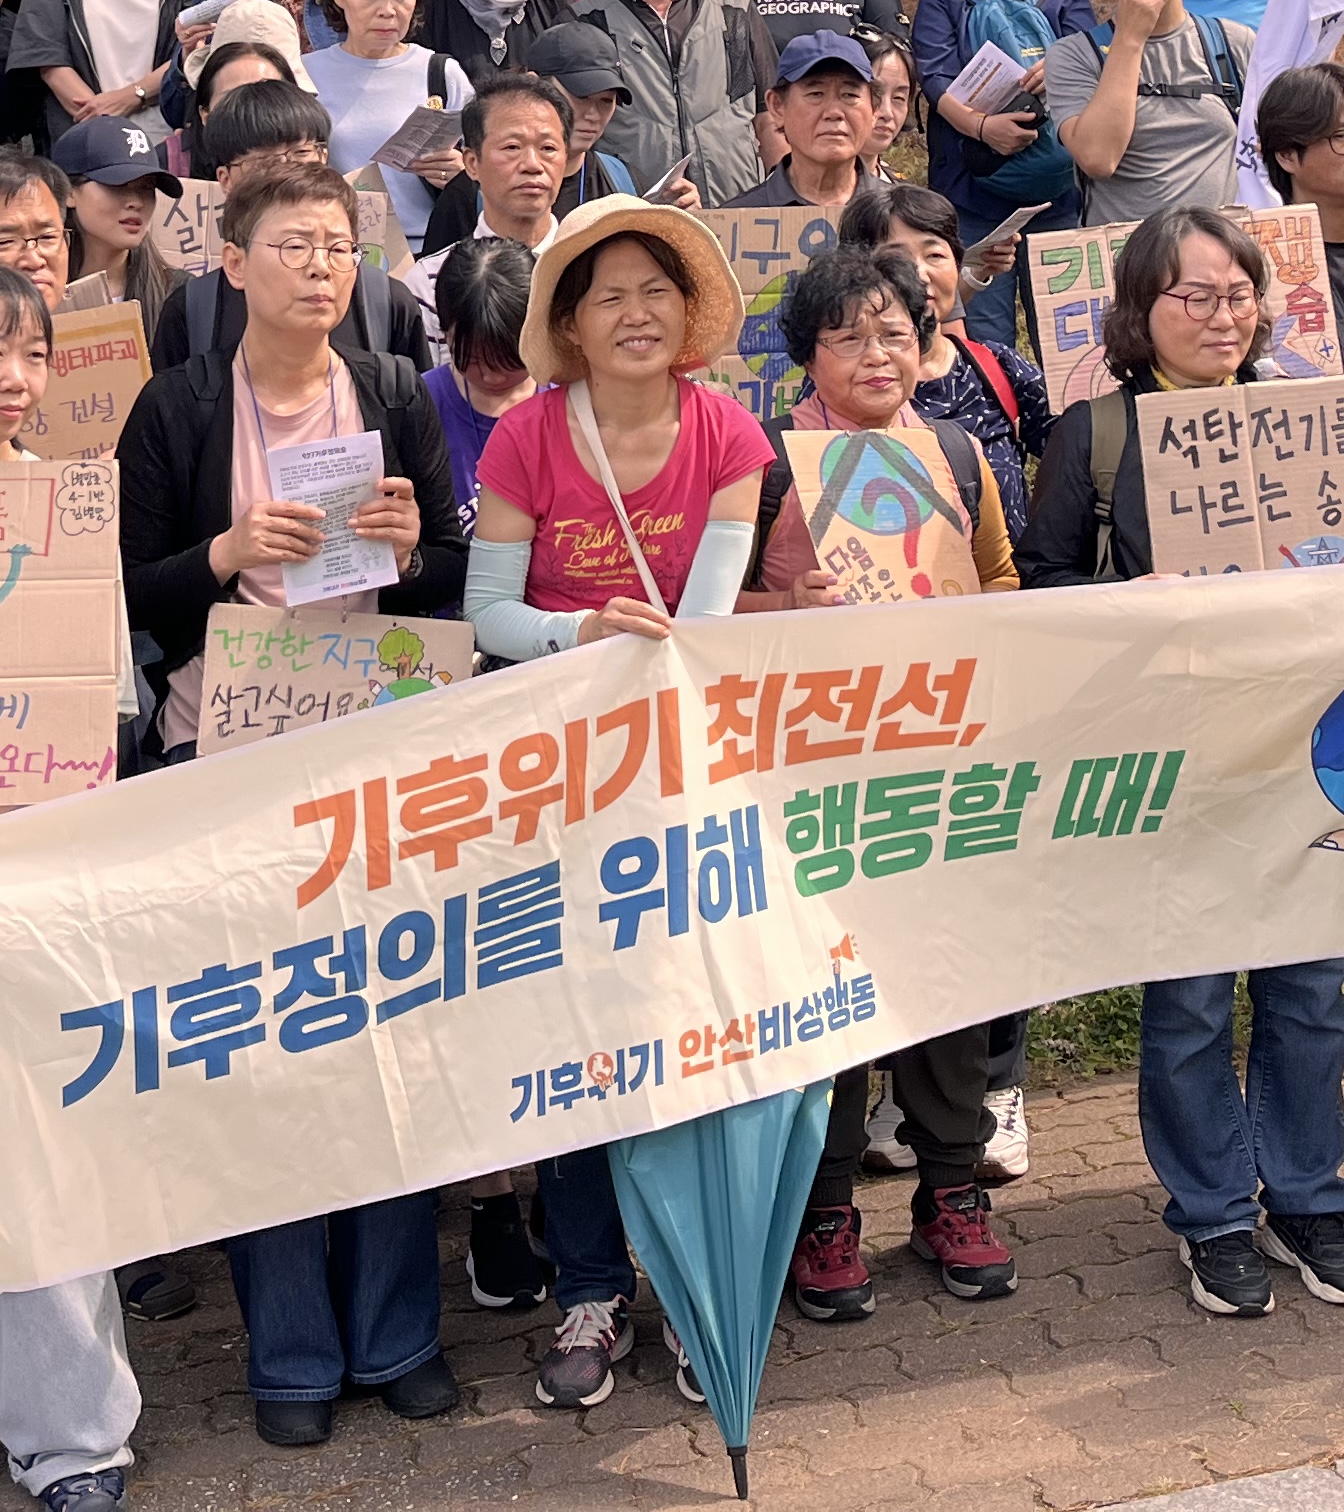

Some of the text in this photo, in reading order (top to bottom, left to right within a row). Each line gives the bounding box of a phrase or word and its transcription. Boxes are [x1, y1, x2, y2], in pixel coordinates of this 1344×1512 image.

[757, 1, 854, 17] GEOGRAPHIC
[58, 392, 118, 424] 건설
[1170, 473, 1292, 534] 나르는
[554, 509, 685, 550] Fresh Green
[563, 551, 602, 568] Love
[604, 548, 618, 566] of
[824, 536, 875, 576] 다음
[213, 628, 315, 673] 건강한
[293, 657, 988, 910] 기후위기 최전선,
[60, 750, 1186, 1109] 기후정의를 위해 행동할 때!
[510, 973, 876, 1124] 기후위기 안산비상행동
